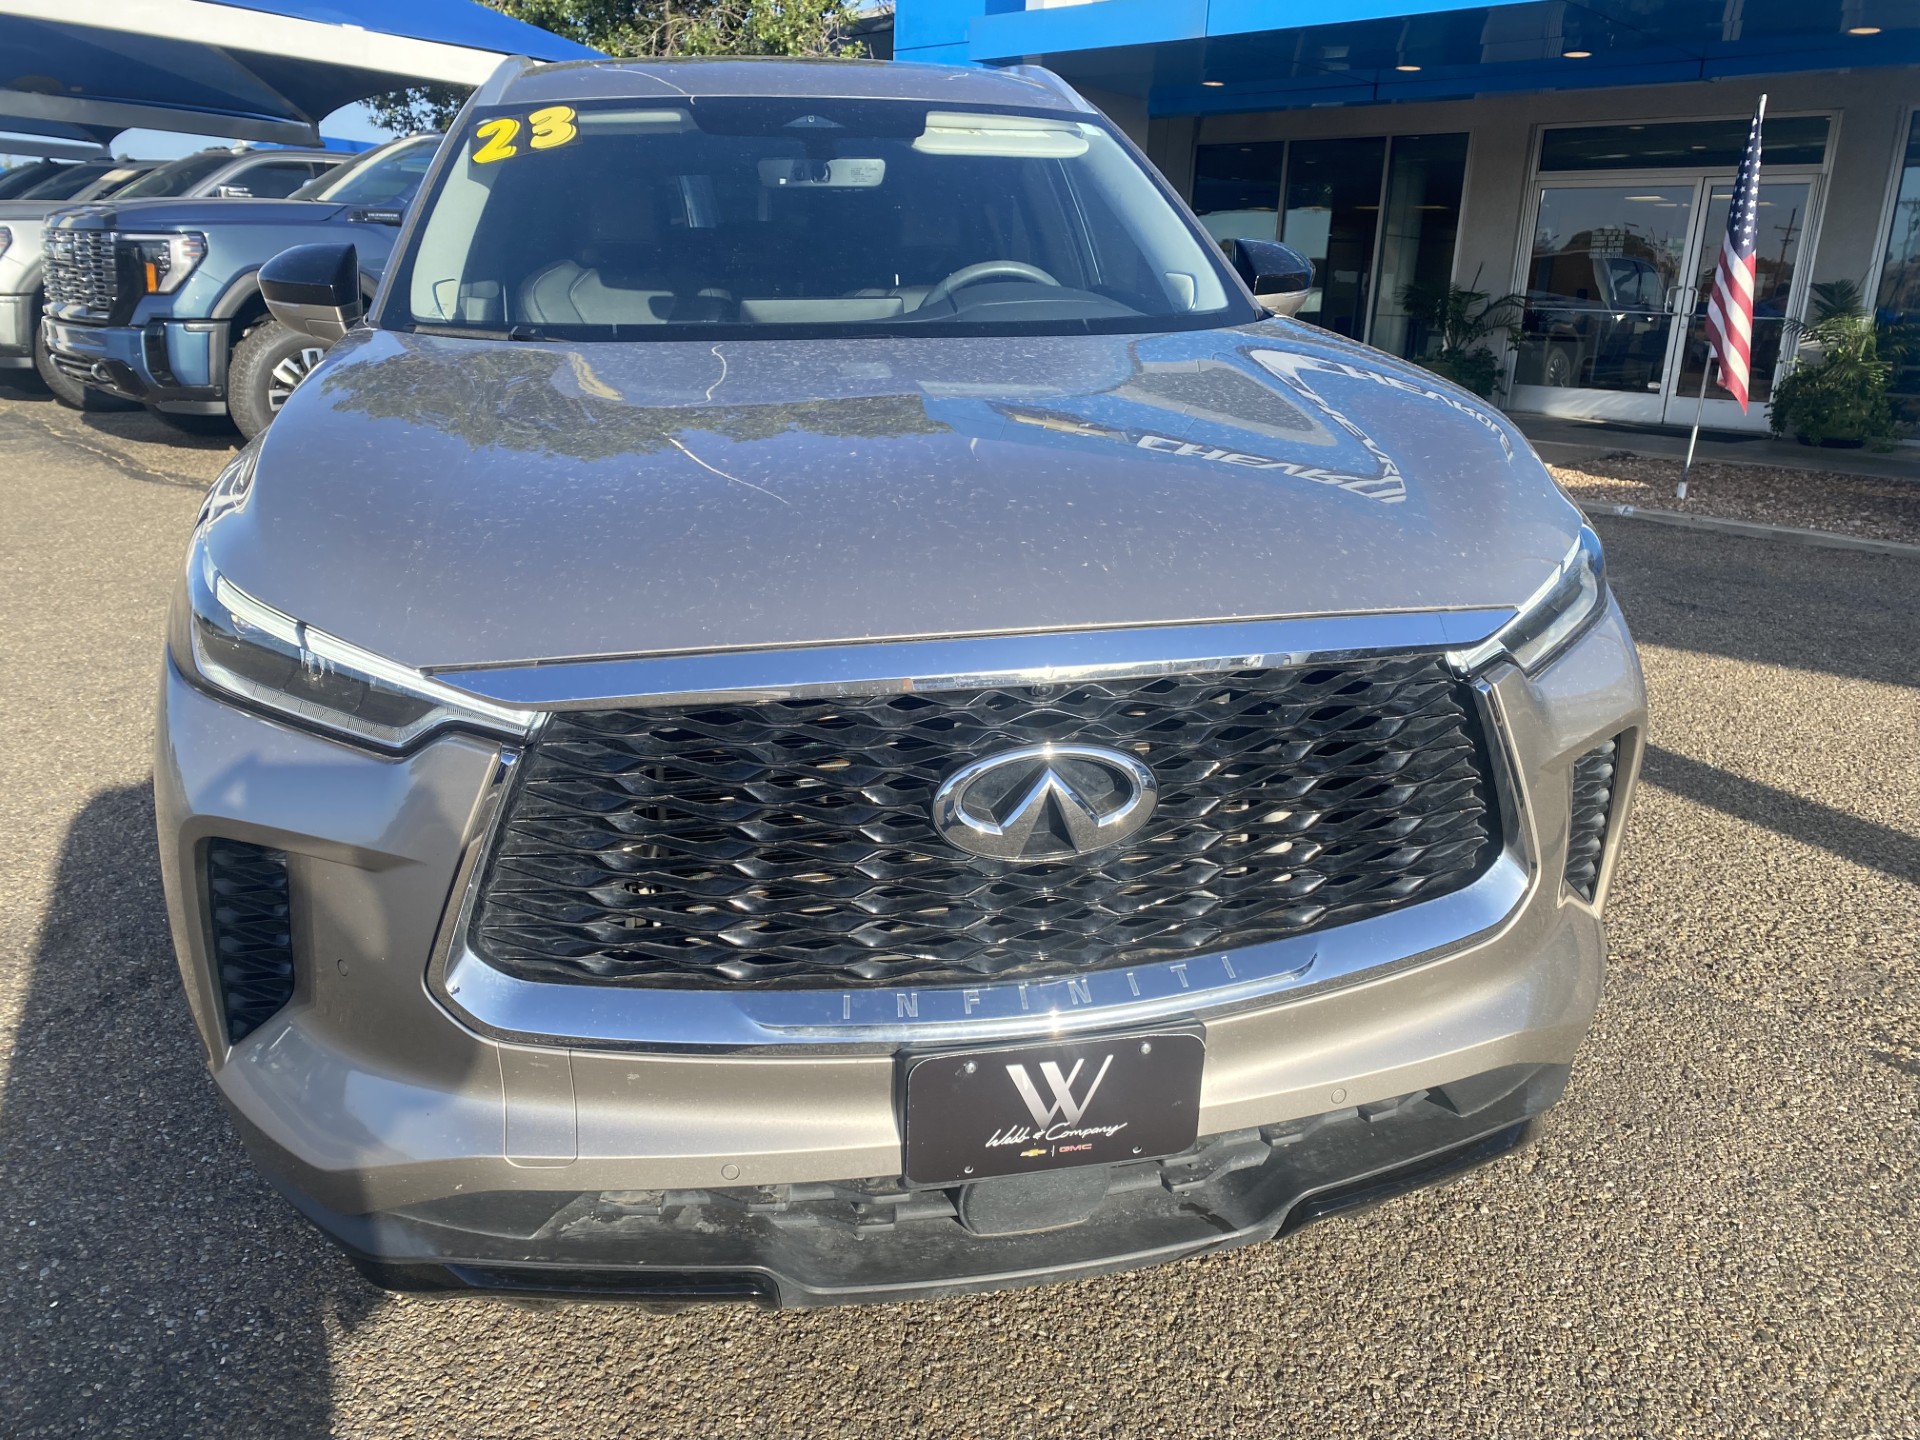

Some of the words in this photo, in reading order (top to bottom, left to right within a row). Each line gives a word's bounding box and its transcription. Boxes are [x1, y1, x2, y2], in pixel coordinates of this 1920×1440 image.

[472, 105, 577, 164] 23
[841, 955, 1237, 1021] INFINITI
[1006, 1054, 1114, 1130] W
[985, 1124, 1030, 1148] Webb
[1032, 1129, 1046, 1141] &
[1045, 1121, 1128, 1141] Company
[1059, 1143, 1093, 1153] GMC
